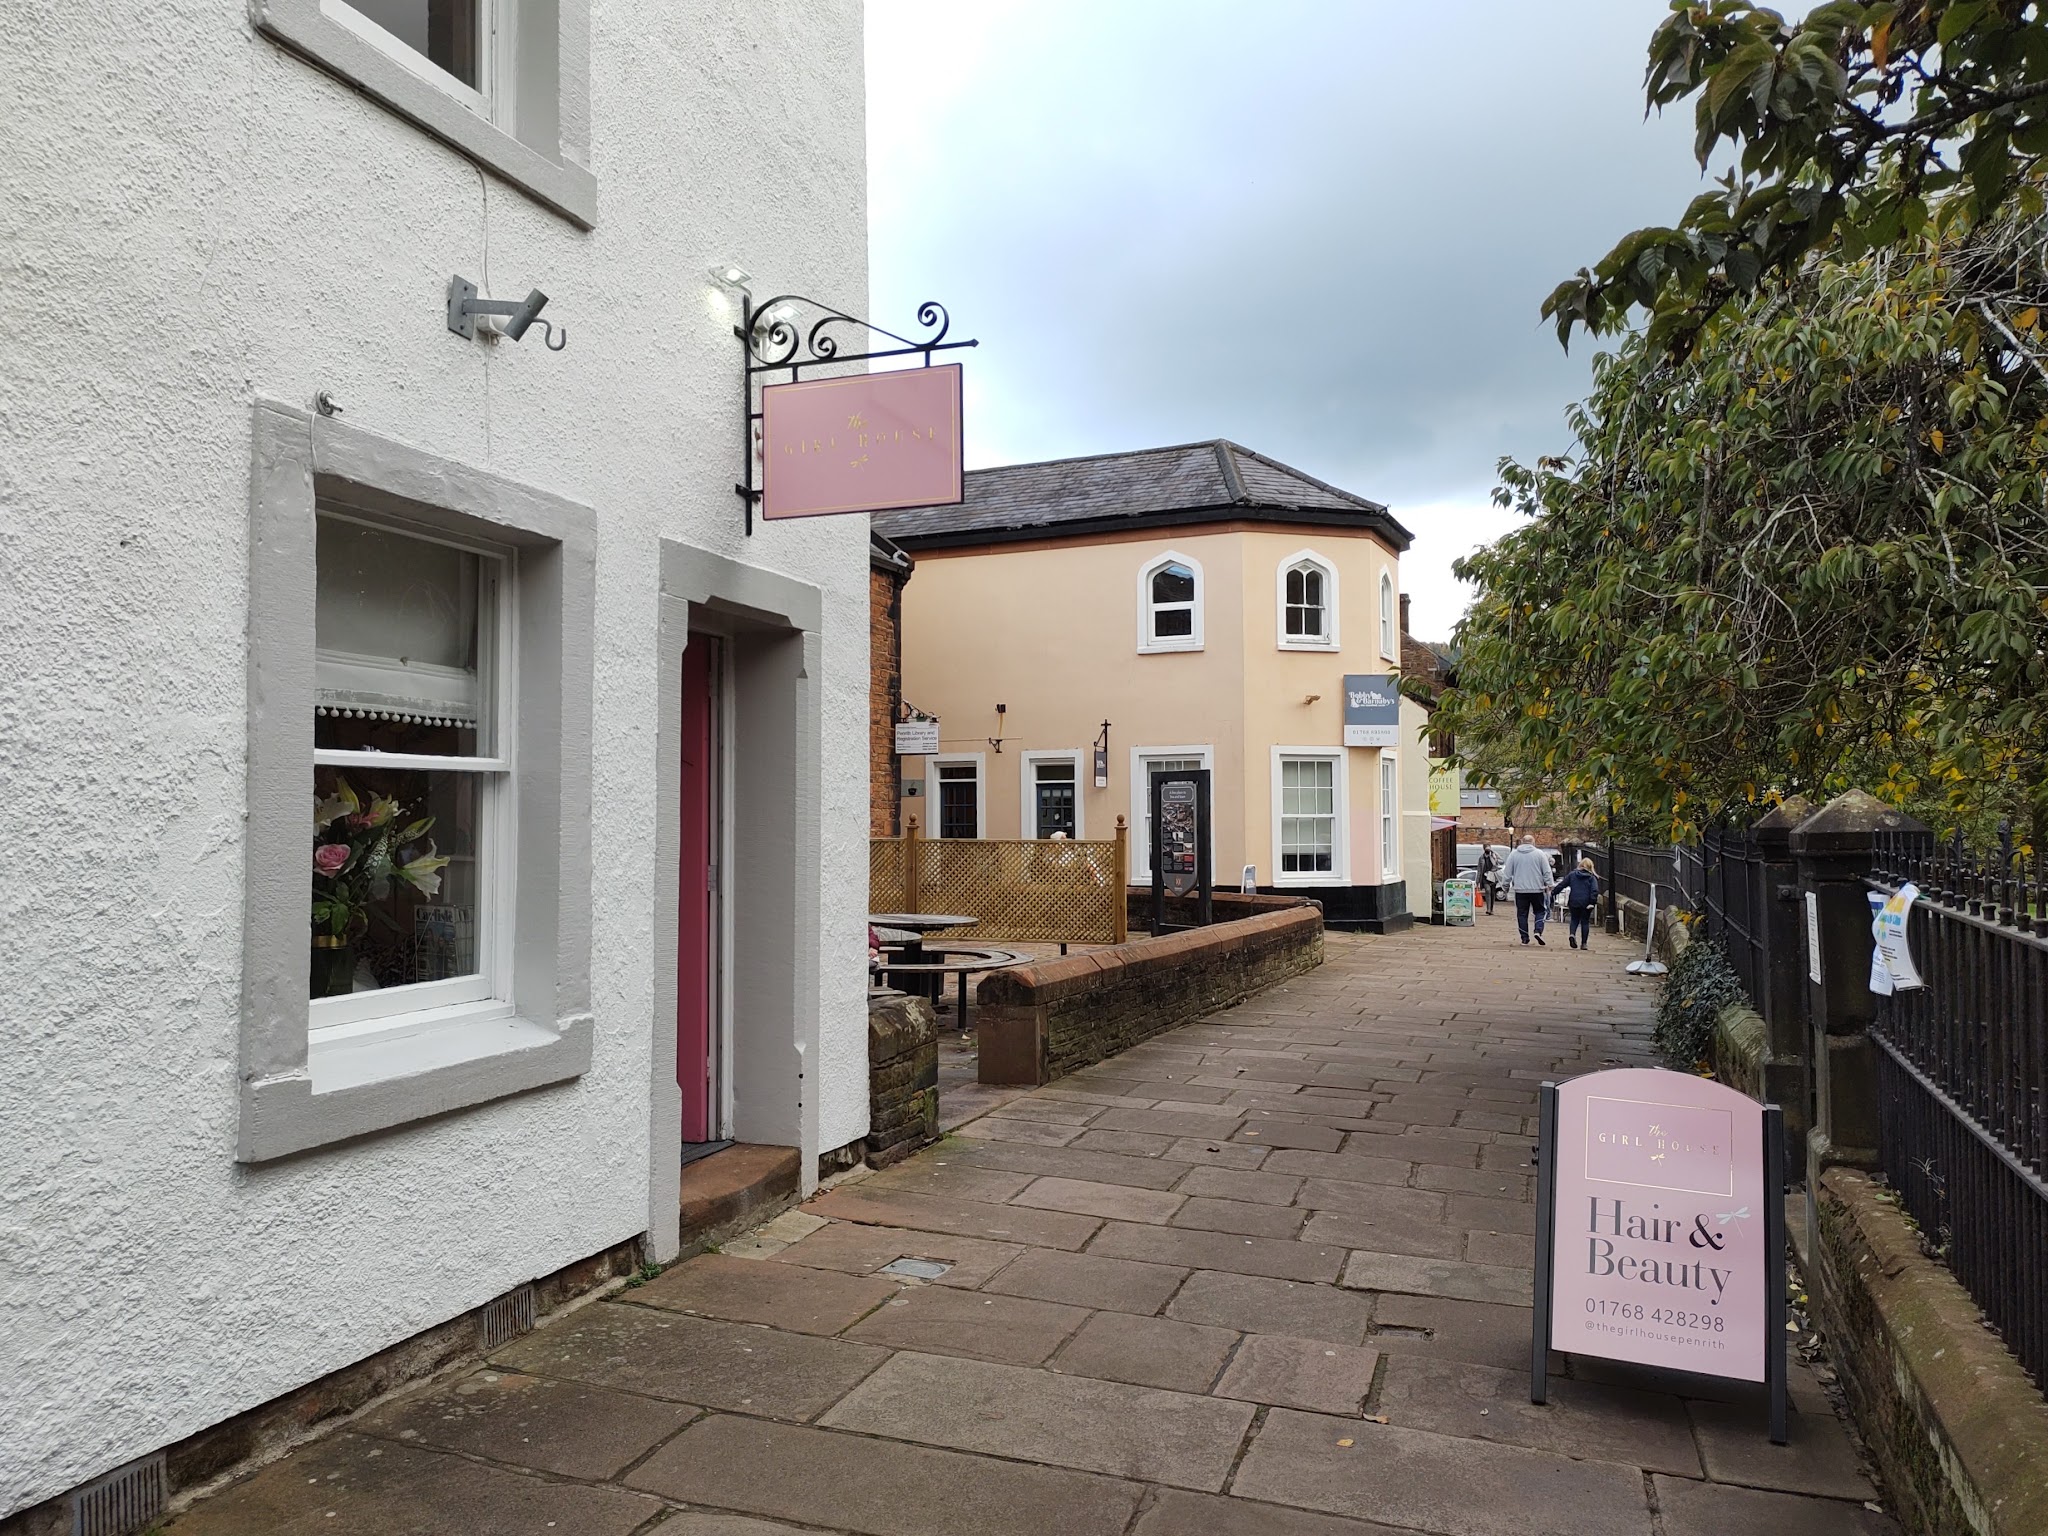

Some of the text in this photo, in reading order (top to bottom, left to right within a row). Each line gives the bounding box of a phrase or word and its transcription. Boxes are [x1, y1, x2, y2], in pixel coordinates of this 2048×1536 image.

[784, 426, 938, 456] GIRL HOUSE
[1363, 697, 1395, 706] Barnaby's
[1598, 1132, 1720, 1156] GIRL HOUSE
[1586, 1195, 1727, 1251] Hair &
[1585, 1236, 1733, 1306] Beauty
[1585, 1297, 1725, 1333] 01768 428298
[1585, 1320, 1726, 1350] @thegirlhousepenrith
